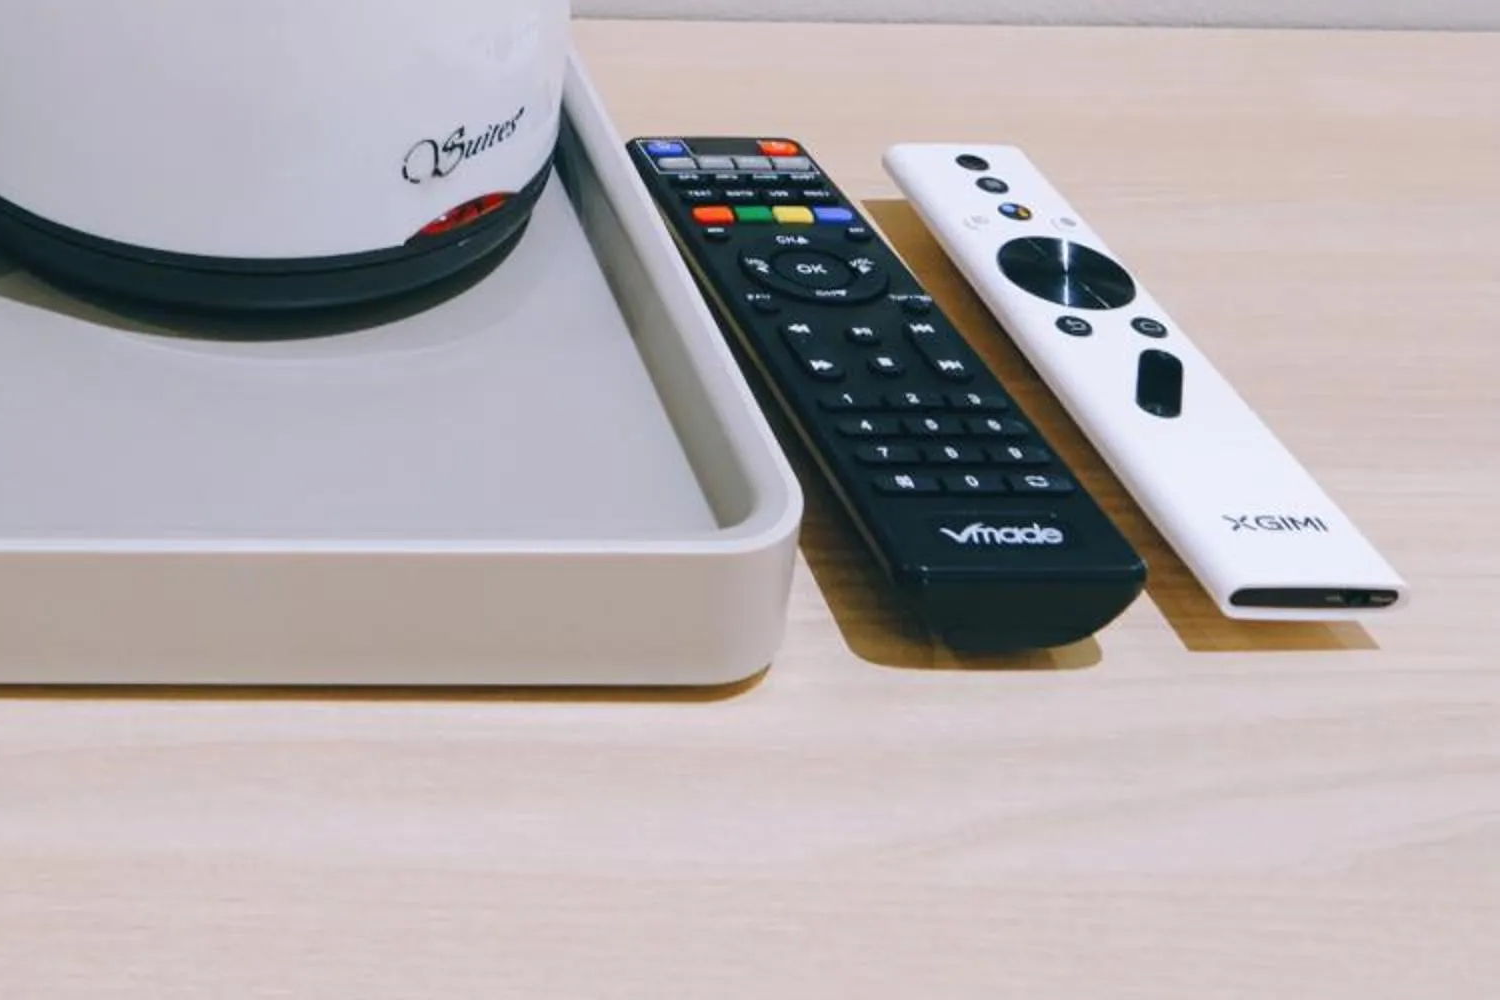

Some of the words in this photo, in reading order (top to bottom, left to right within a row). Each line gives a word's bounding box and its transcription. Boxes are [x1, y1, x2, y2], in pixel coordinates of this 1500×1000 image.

[905, 392, 920, 404] 2
[876, 446, 888, 458] 7
[1222, 515, 1328, 532] XGIMI
[940, 523, 1064, 545] Vmade
